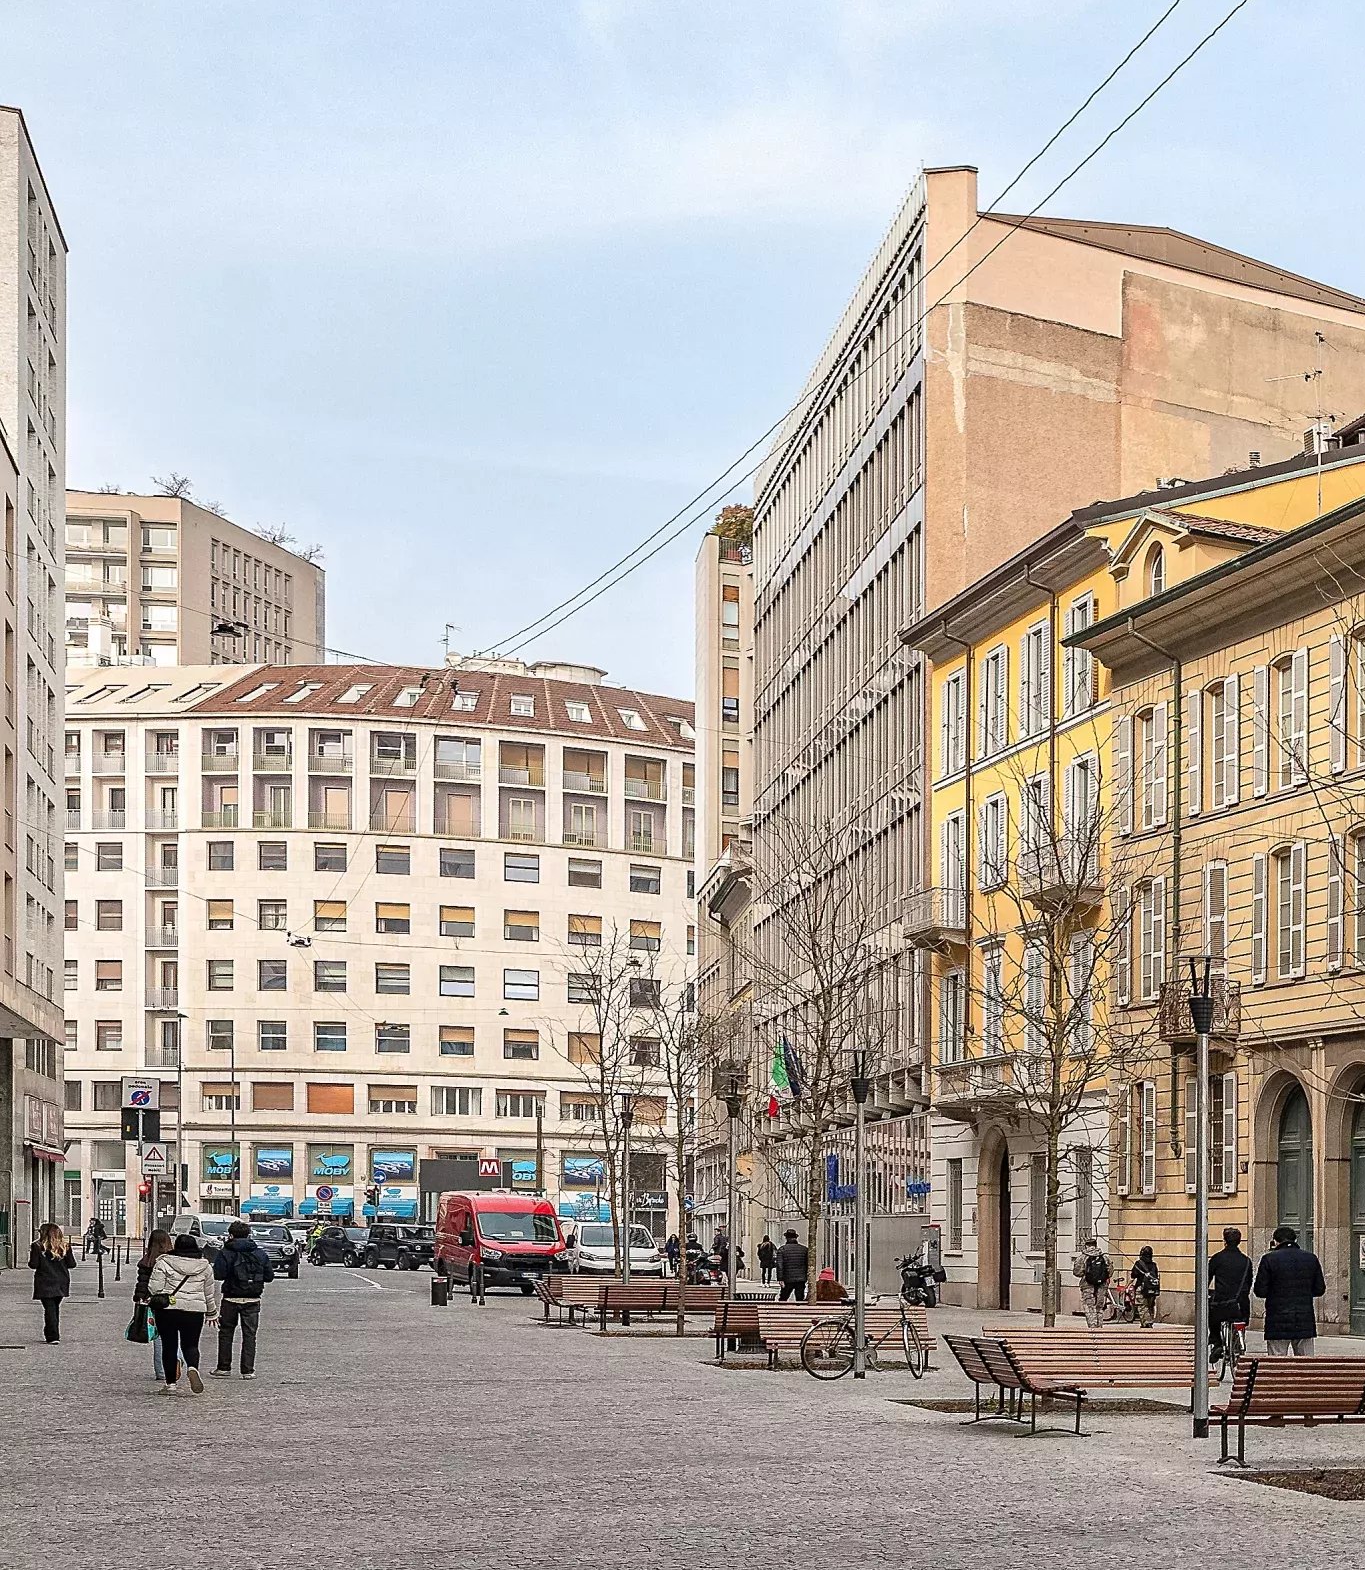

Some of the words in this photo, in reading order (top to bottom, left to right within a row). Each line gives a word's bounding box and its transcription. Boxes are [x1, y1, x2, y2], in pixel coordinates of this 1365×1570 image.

[313, 1167, 350, 1176] MOBY
[480, 1161, 499, 1174] M
[512, 1172, 537, 1181] OBY
